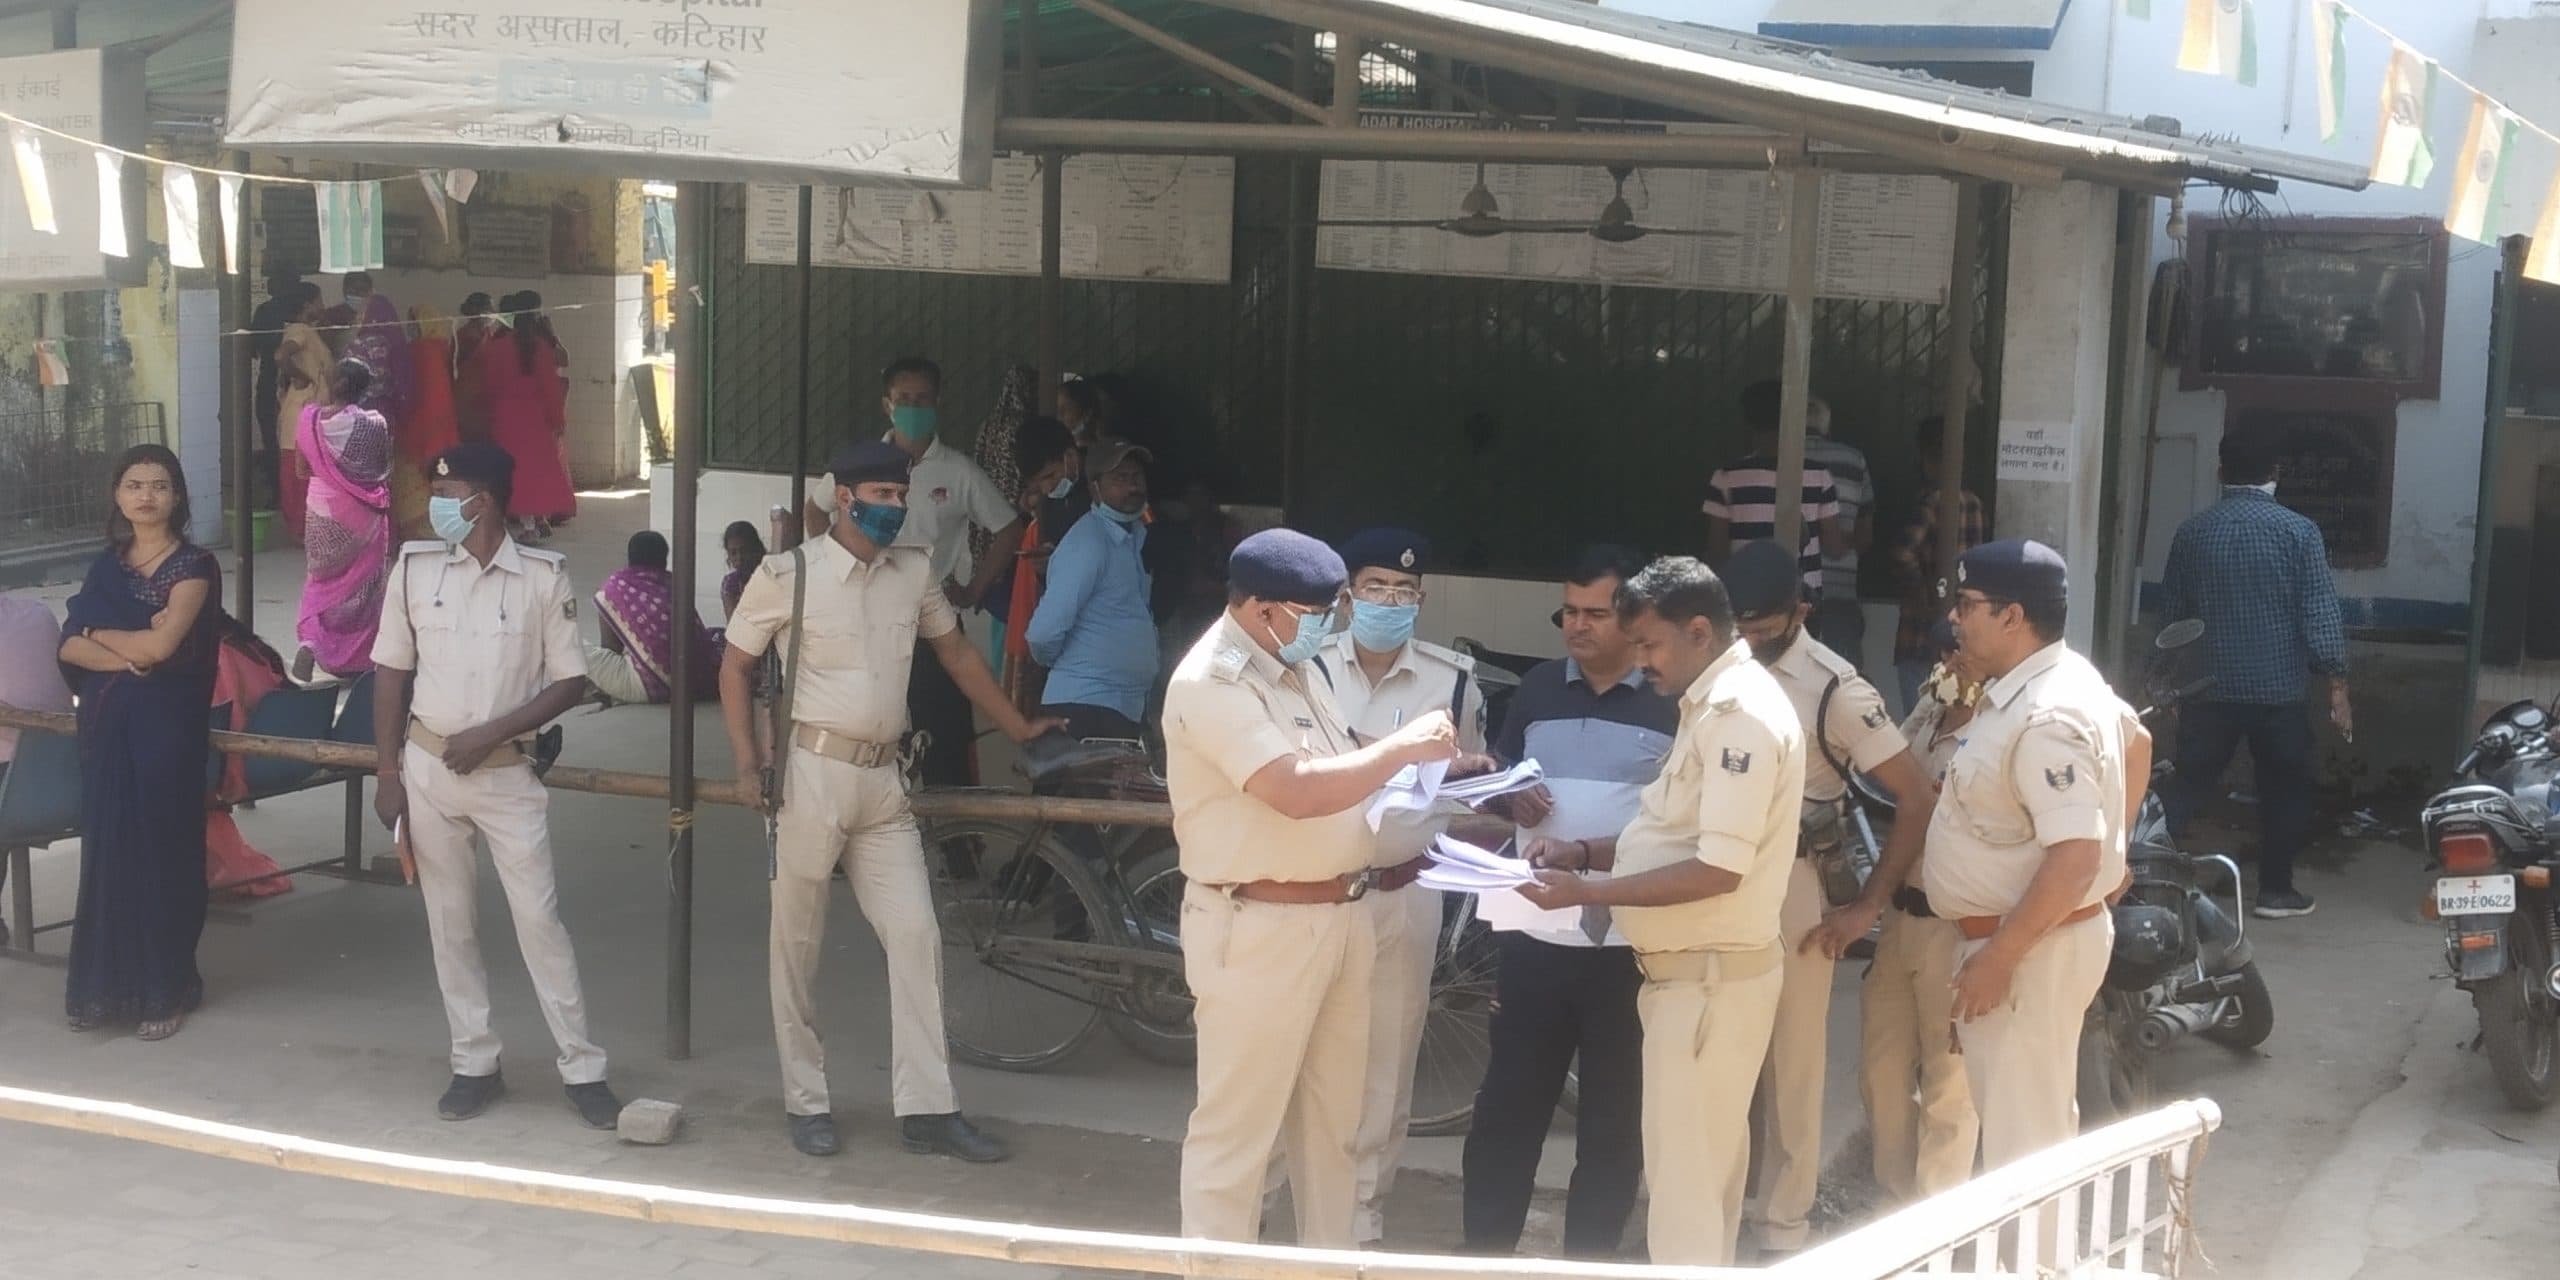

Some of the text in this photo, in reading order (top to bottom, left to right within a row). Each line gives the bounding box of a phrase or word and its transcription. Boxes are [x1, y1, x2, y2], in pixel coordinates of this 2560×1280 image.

[415, 11, 480, 39] सदर
[651, 12, 769, 53] कटिहार
[1360, 114, 1398, 130] ADAR
